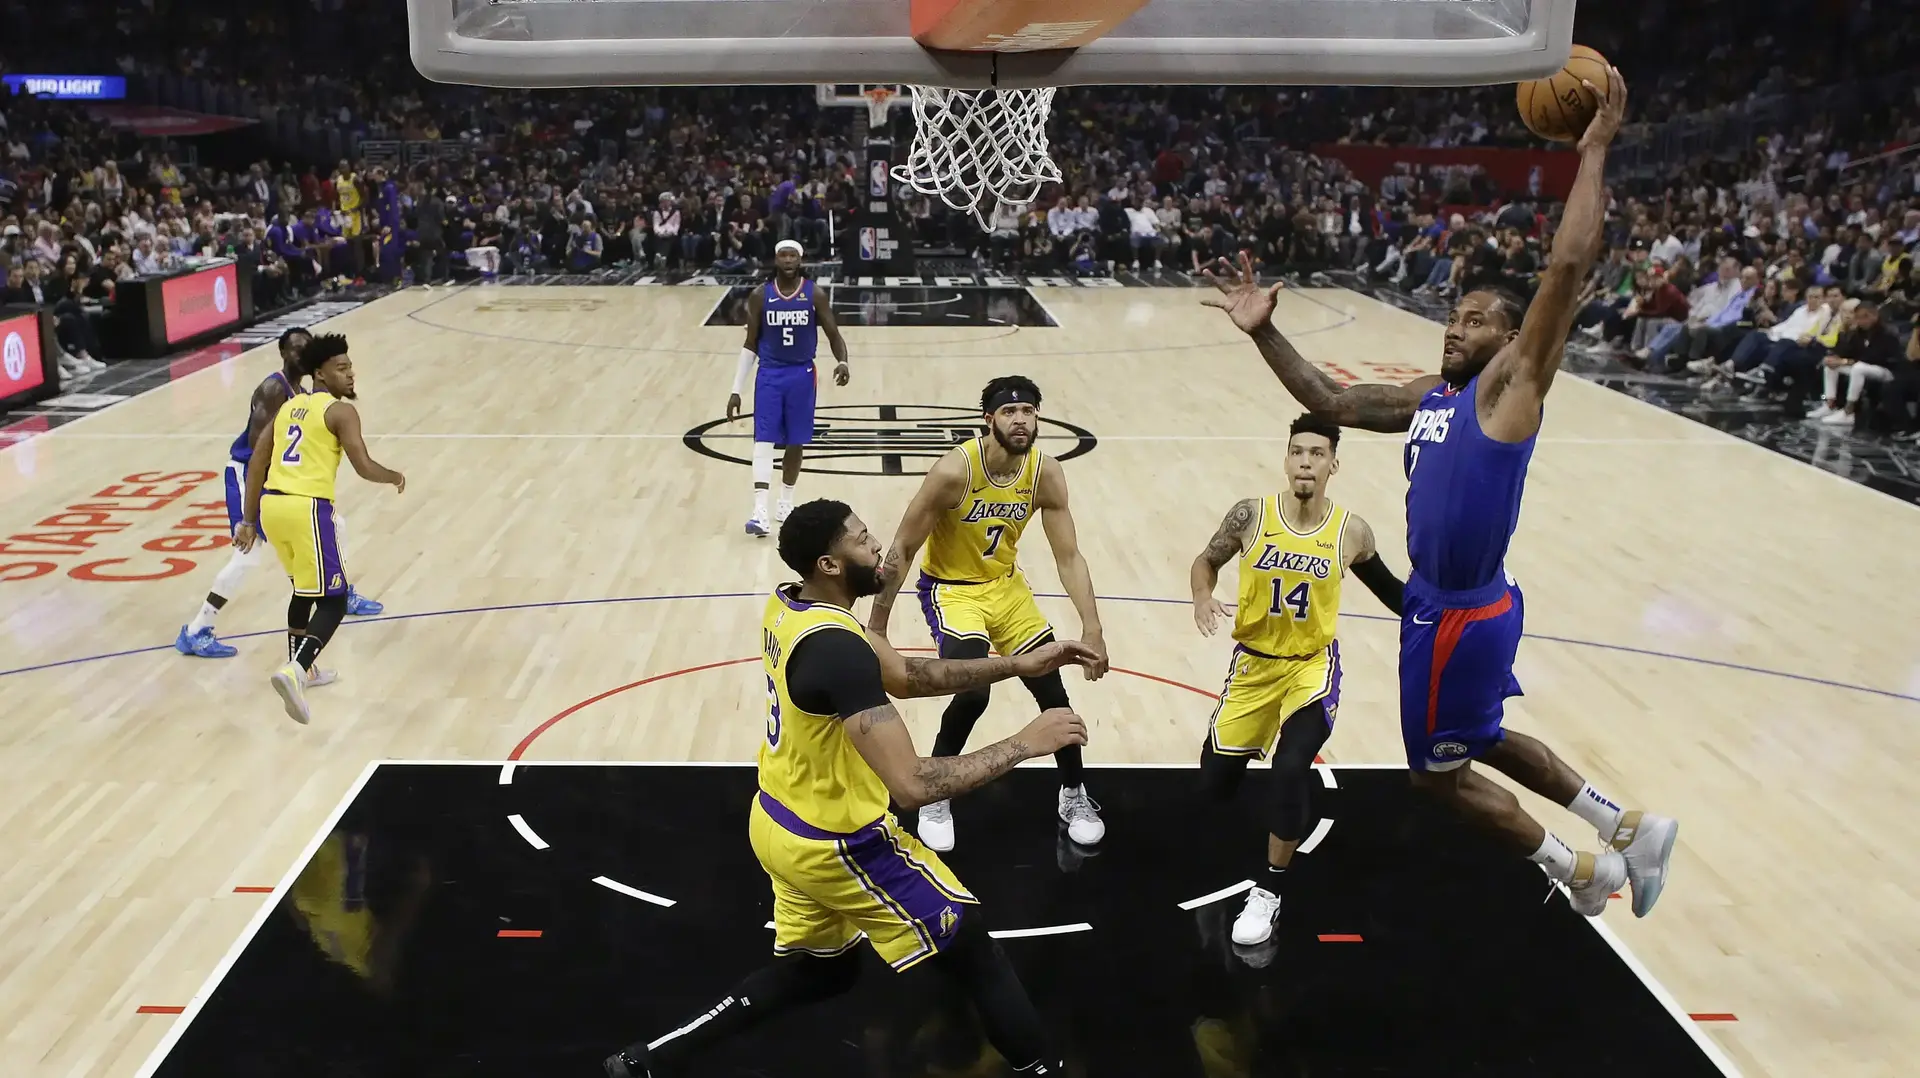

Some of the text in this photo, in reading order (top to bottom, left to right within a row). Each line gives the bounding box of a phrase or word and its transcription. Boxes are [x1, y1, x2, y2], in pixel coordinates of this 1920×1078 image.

[58, 79, 102, 95] LIGHT
[766, 309, 809, 326] CLIPPERS
[782, 327, 794, 346] 5
[290, 407, 309, 421] COOK
[282, 424, 303, 465] 2
[960, 498, 1029, 524] LAKERS
[67, 500, 234, 582] Cent
[981, 526, 1006, 560] 7
[1315, 540, 1335, 550] wish
[1251, 543, 1332, 580] LAKERS
[1268, 576, 1312, 622] 14
[763, 627, 782, 669] DAVIS
[765, 671, 781, 750] 3
